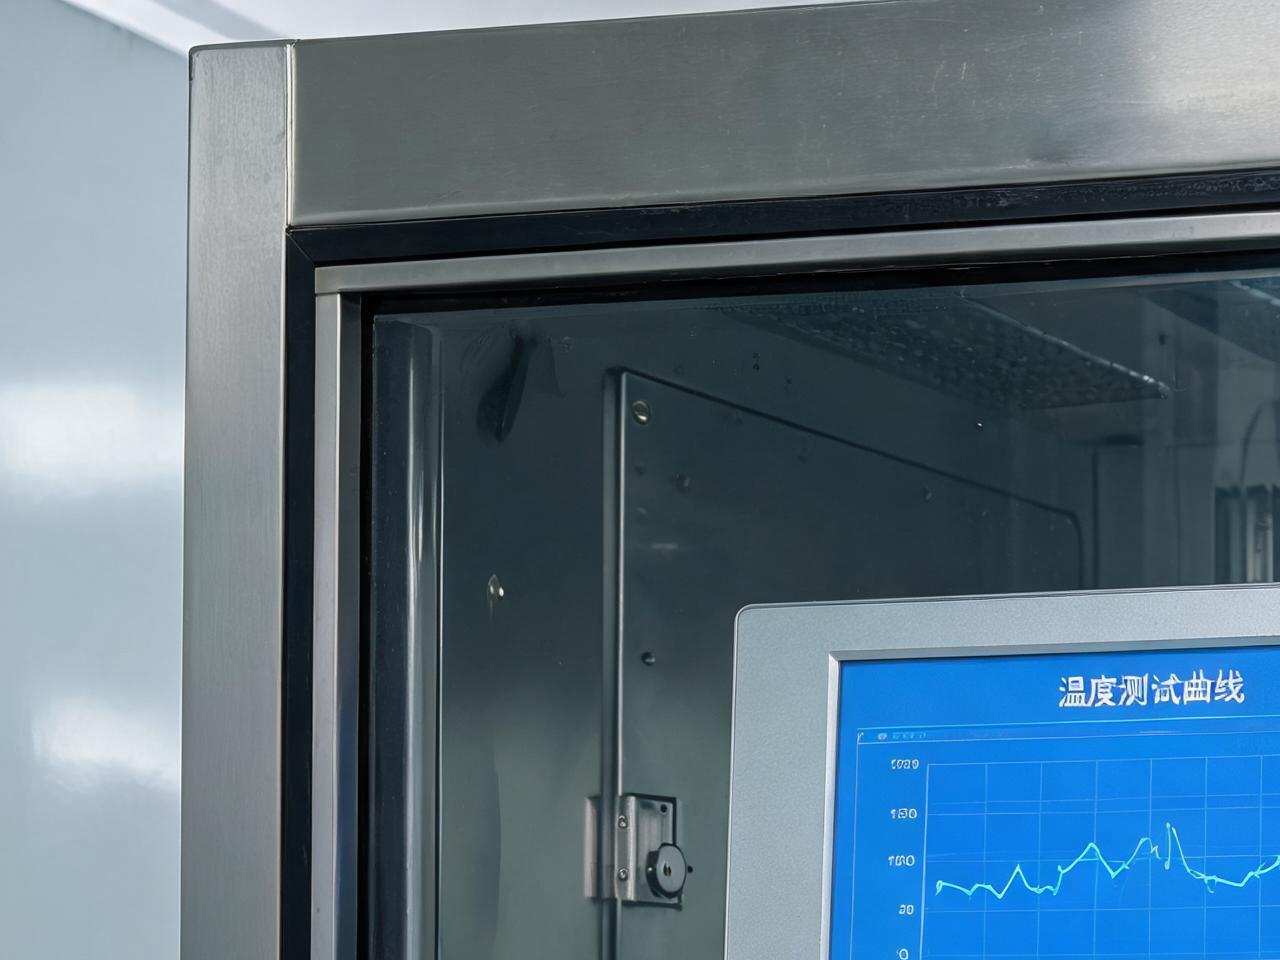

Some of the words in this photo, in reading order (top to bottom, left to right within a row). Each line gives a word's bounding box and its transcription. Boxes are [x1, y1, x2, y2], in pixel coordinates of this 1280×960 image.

[1058, 668, 1246, 708] 温度测试曲线
